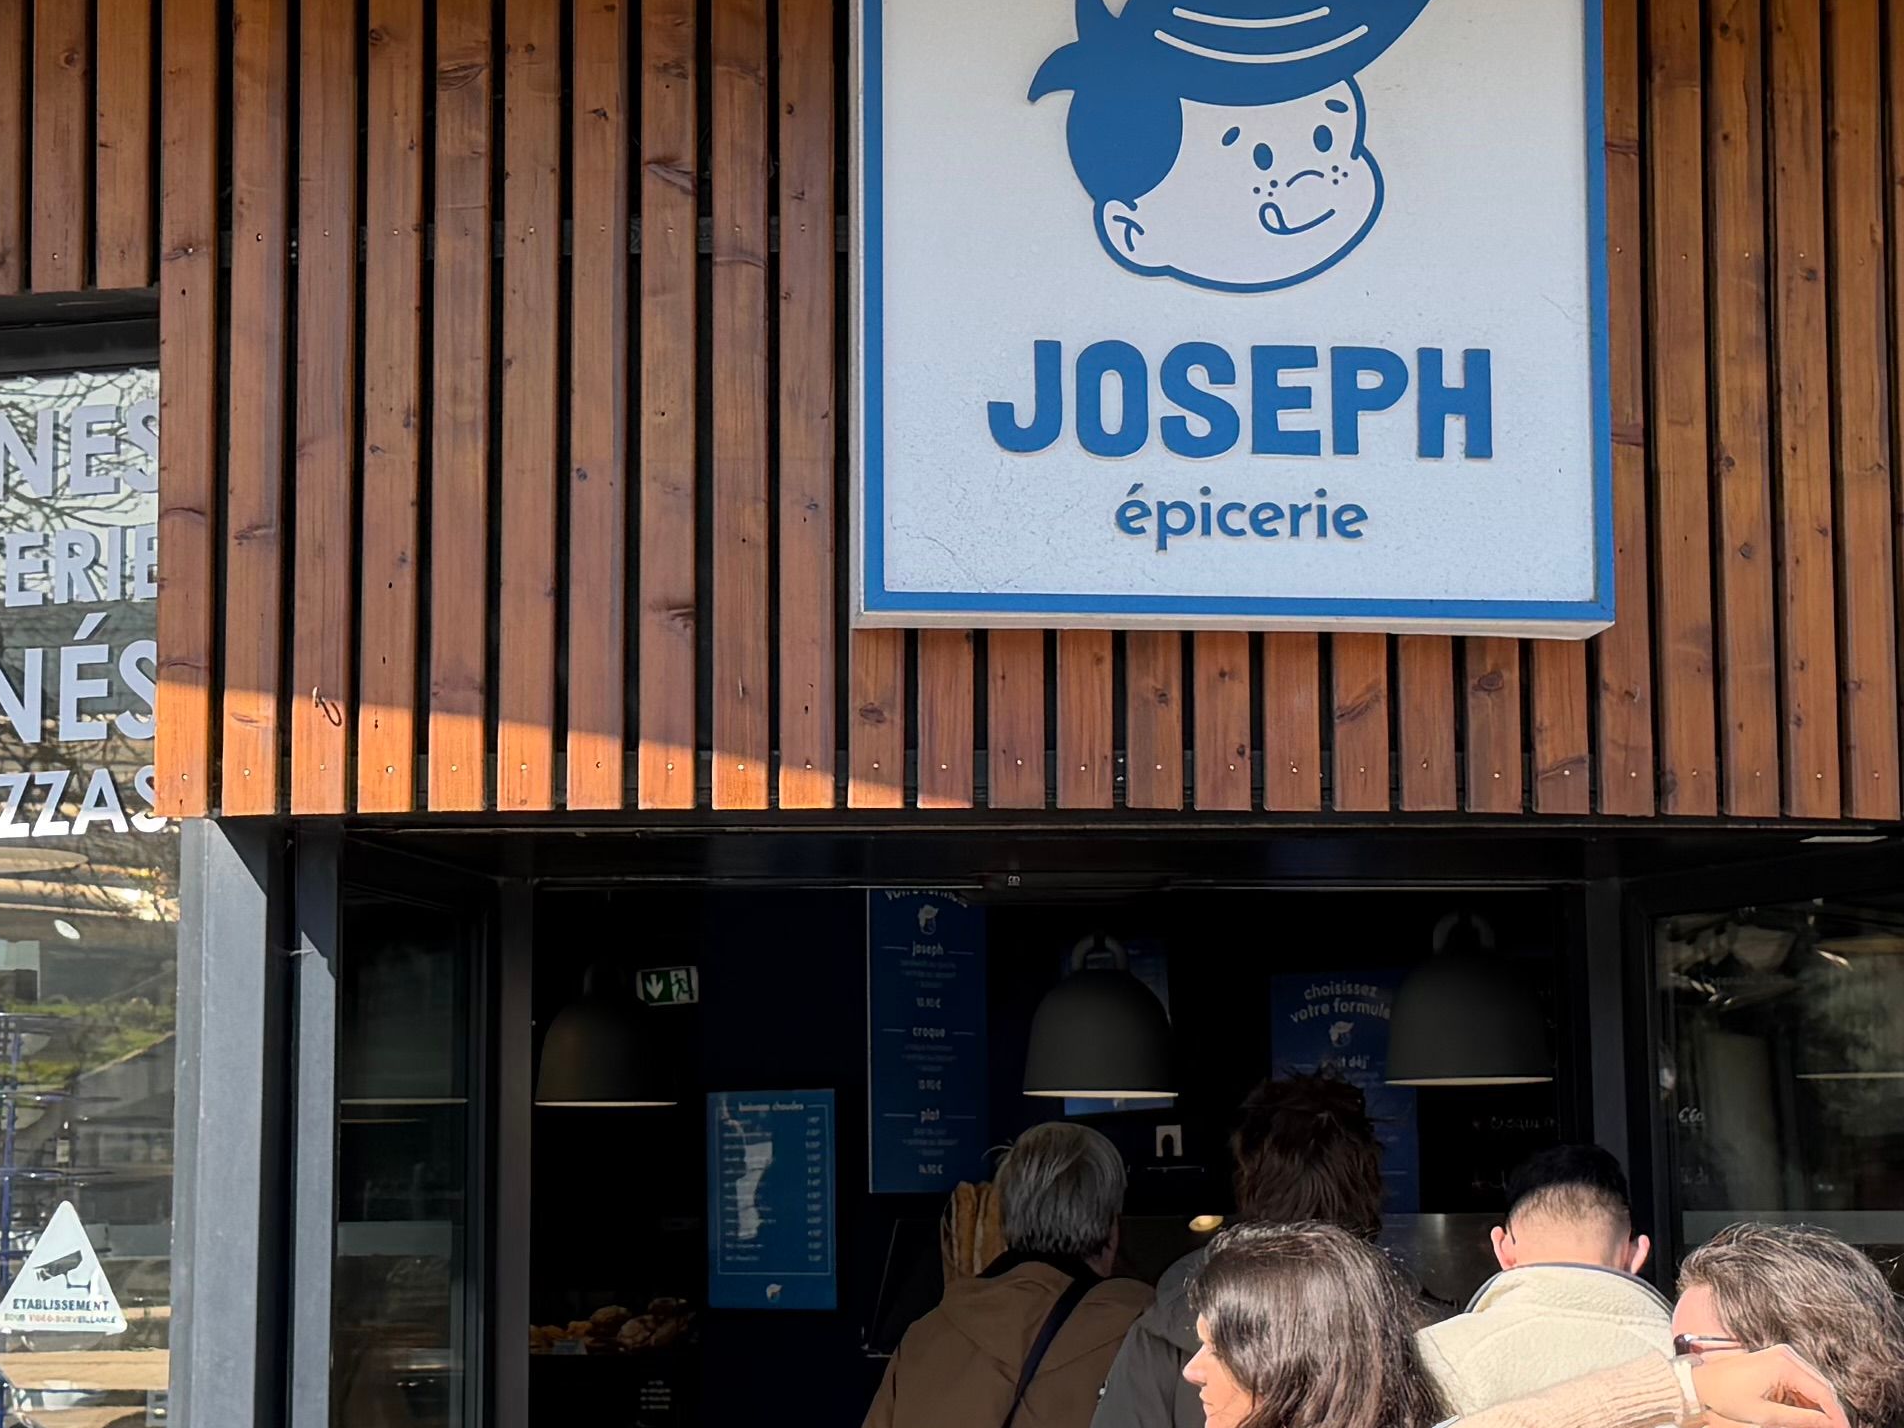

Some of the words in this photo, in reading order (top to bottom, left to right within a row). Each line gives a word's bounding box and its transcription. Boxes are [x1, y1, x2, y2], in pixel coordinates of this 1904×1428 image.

[987, 339, 1494, 461] JOSEPH
[1115, 481, 1369, 552] épicerie
[1303, 980, 1379, 1001] choisissez
[1289, 1000, 1331, 1024] votre
[1332, 997, 1393, 1021] formule
[911, 1026, 947, 1043] croque
[13, 1298, 109, 1312] ETABLISSEMENT
